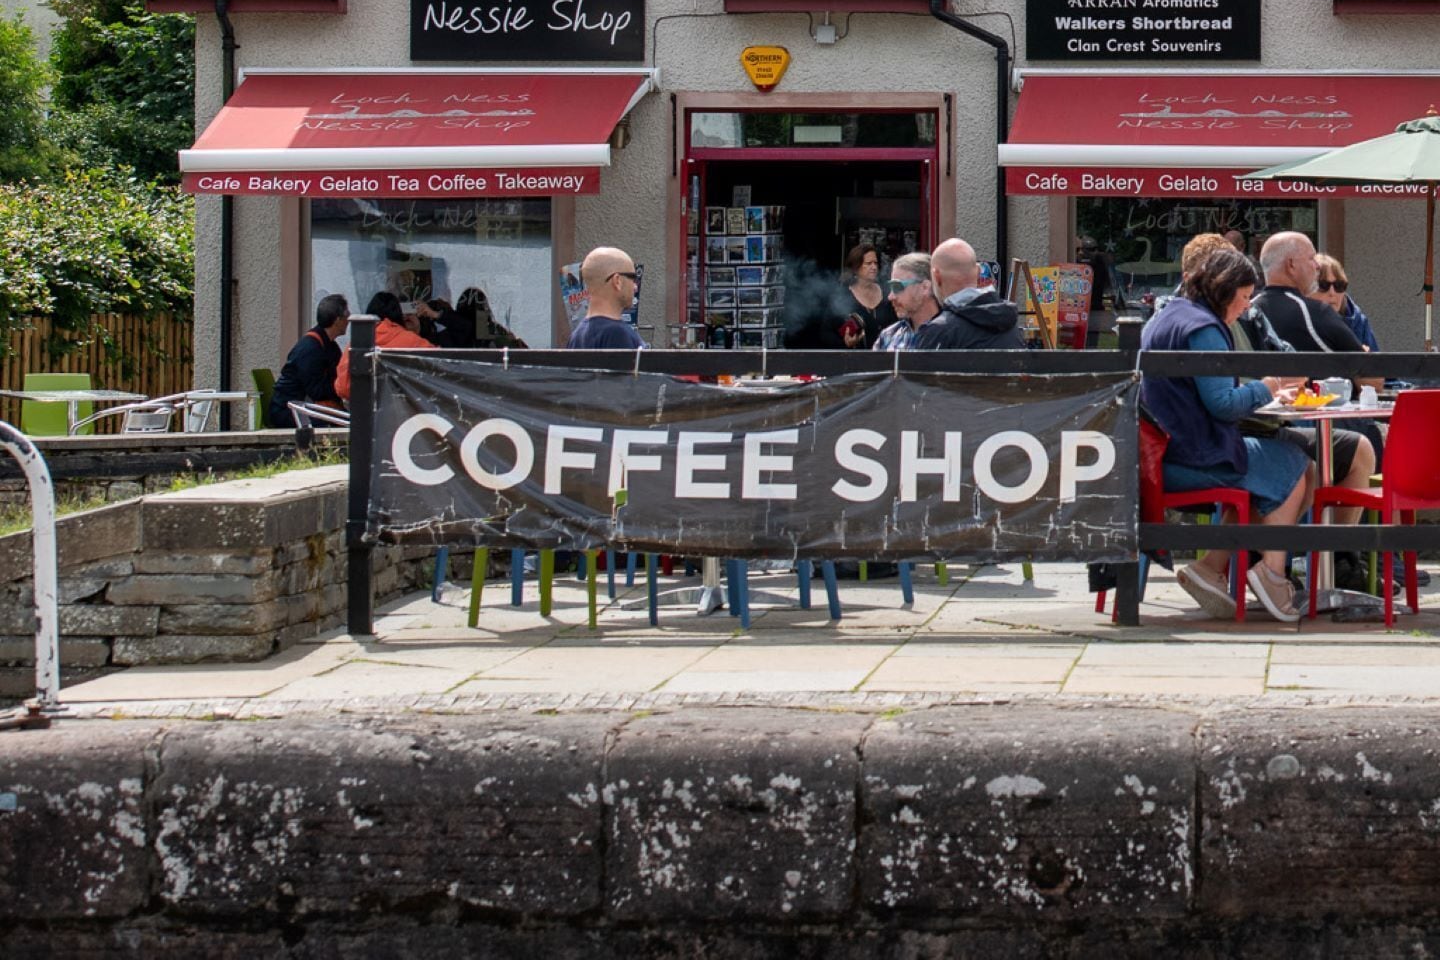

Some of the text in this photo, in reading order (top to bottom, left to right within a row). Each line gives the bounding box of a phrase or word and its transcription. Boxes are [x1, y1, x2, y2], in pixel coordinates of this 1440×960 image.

[1055, 16, 1233, 30] Walkers Shortbread
[1067, 39, 1222, 52] Clan Crest Souvenirs
[330, 92, 530, 104] Loch Ness
[1138, 92, 1338, 104] Loch Ness
[295, 118, 531, 132] Nessie Shop
[1117, 119, 1353, 133] Nessie Shop
[198, 173, 584, 194] Cafe Bakery Gelato Tea Coffee Takeaway
[1025, 174, 1068, 191] Cafe
[1081, 174, 1145, 194] Bakery
[1158, 175, 1218, 191] Gelato
[391, 412, 1116, 504] COFFEE SHOP
